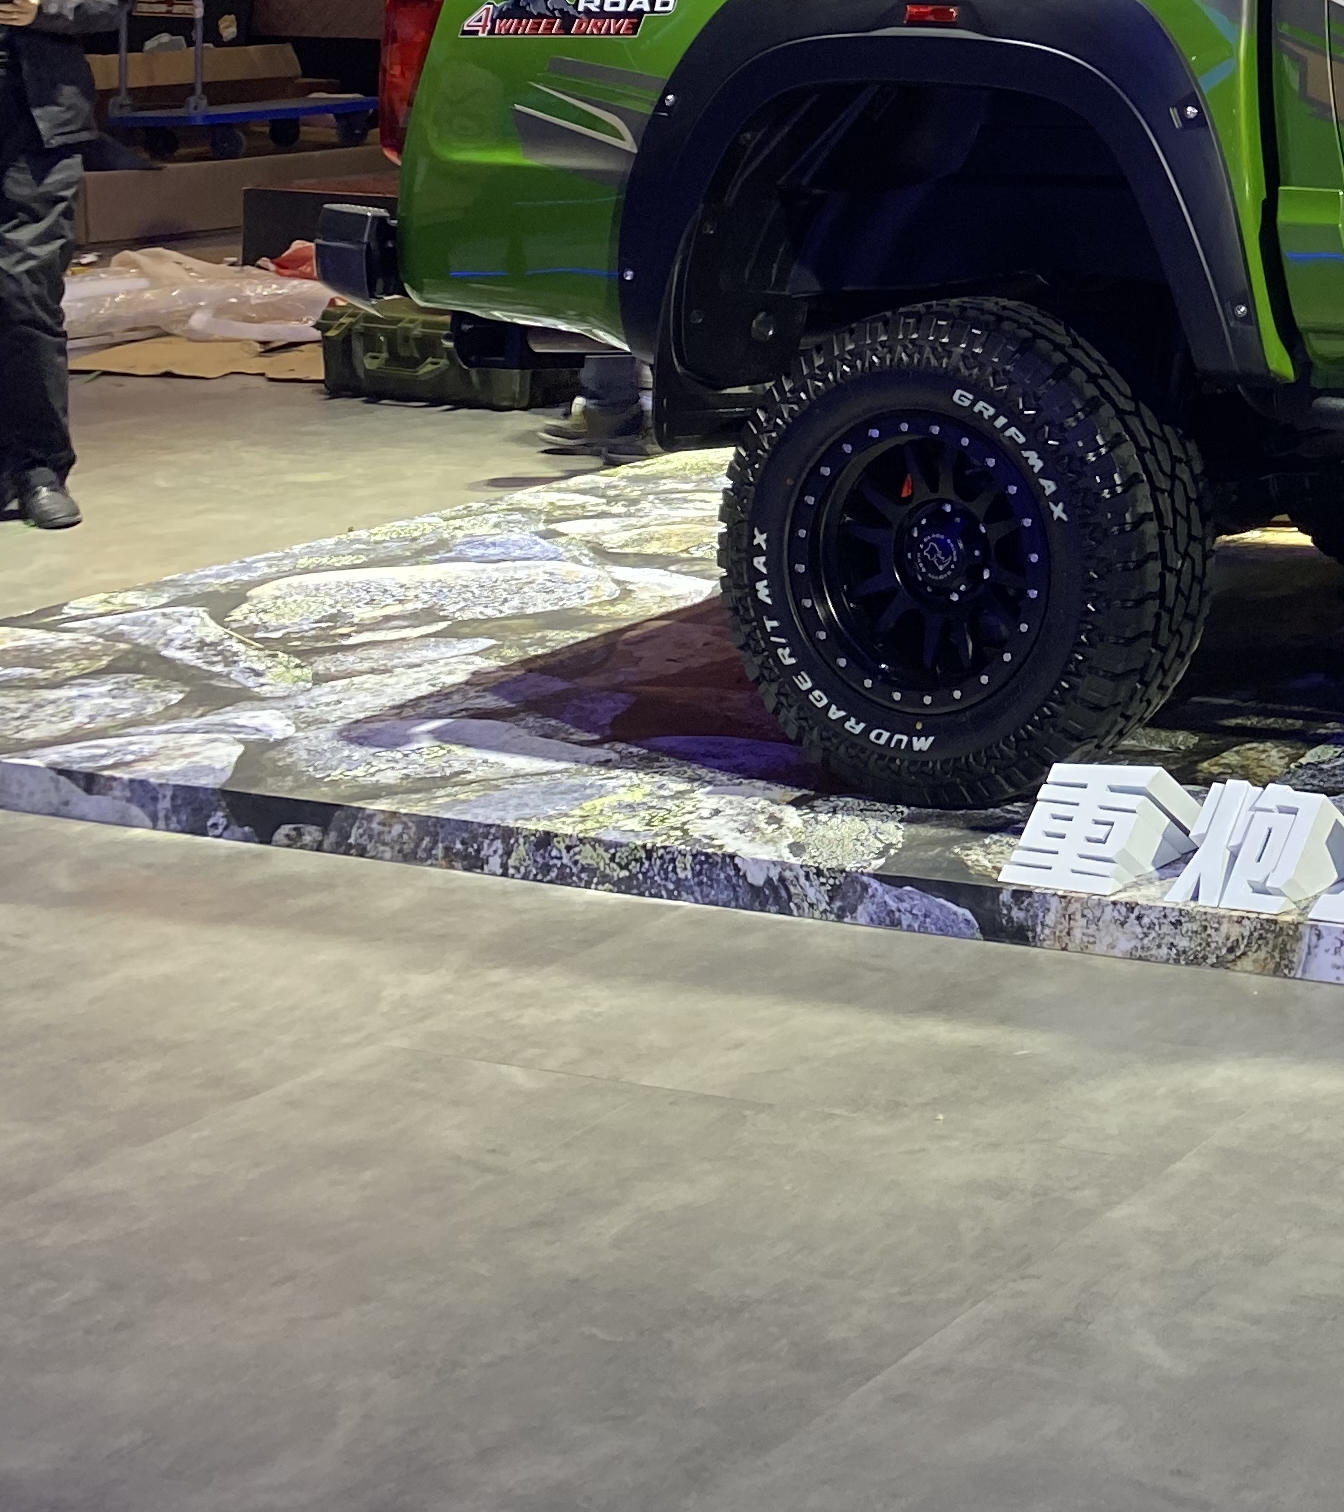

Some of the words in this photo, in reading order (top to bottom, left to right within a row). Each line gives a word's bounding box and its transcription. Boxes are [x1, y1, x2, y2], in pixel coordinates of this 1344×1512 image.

[463, 4, 494, 36] 4
[494, 18, 565, 35] WHEEL
[570, 18, 639, 35] DRIVE
[952, 388, 1069, 522] GRIPMAX
[752, 526, 773, 606] MAX
[792, 670, 868, 735] RAGE
[868, 728, 935, 752] MUD
